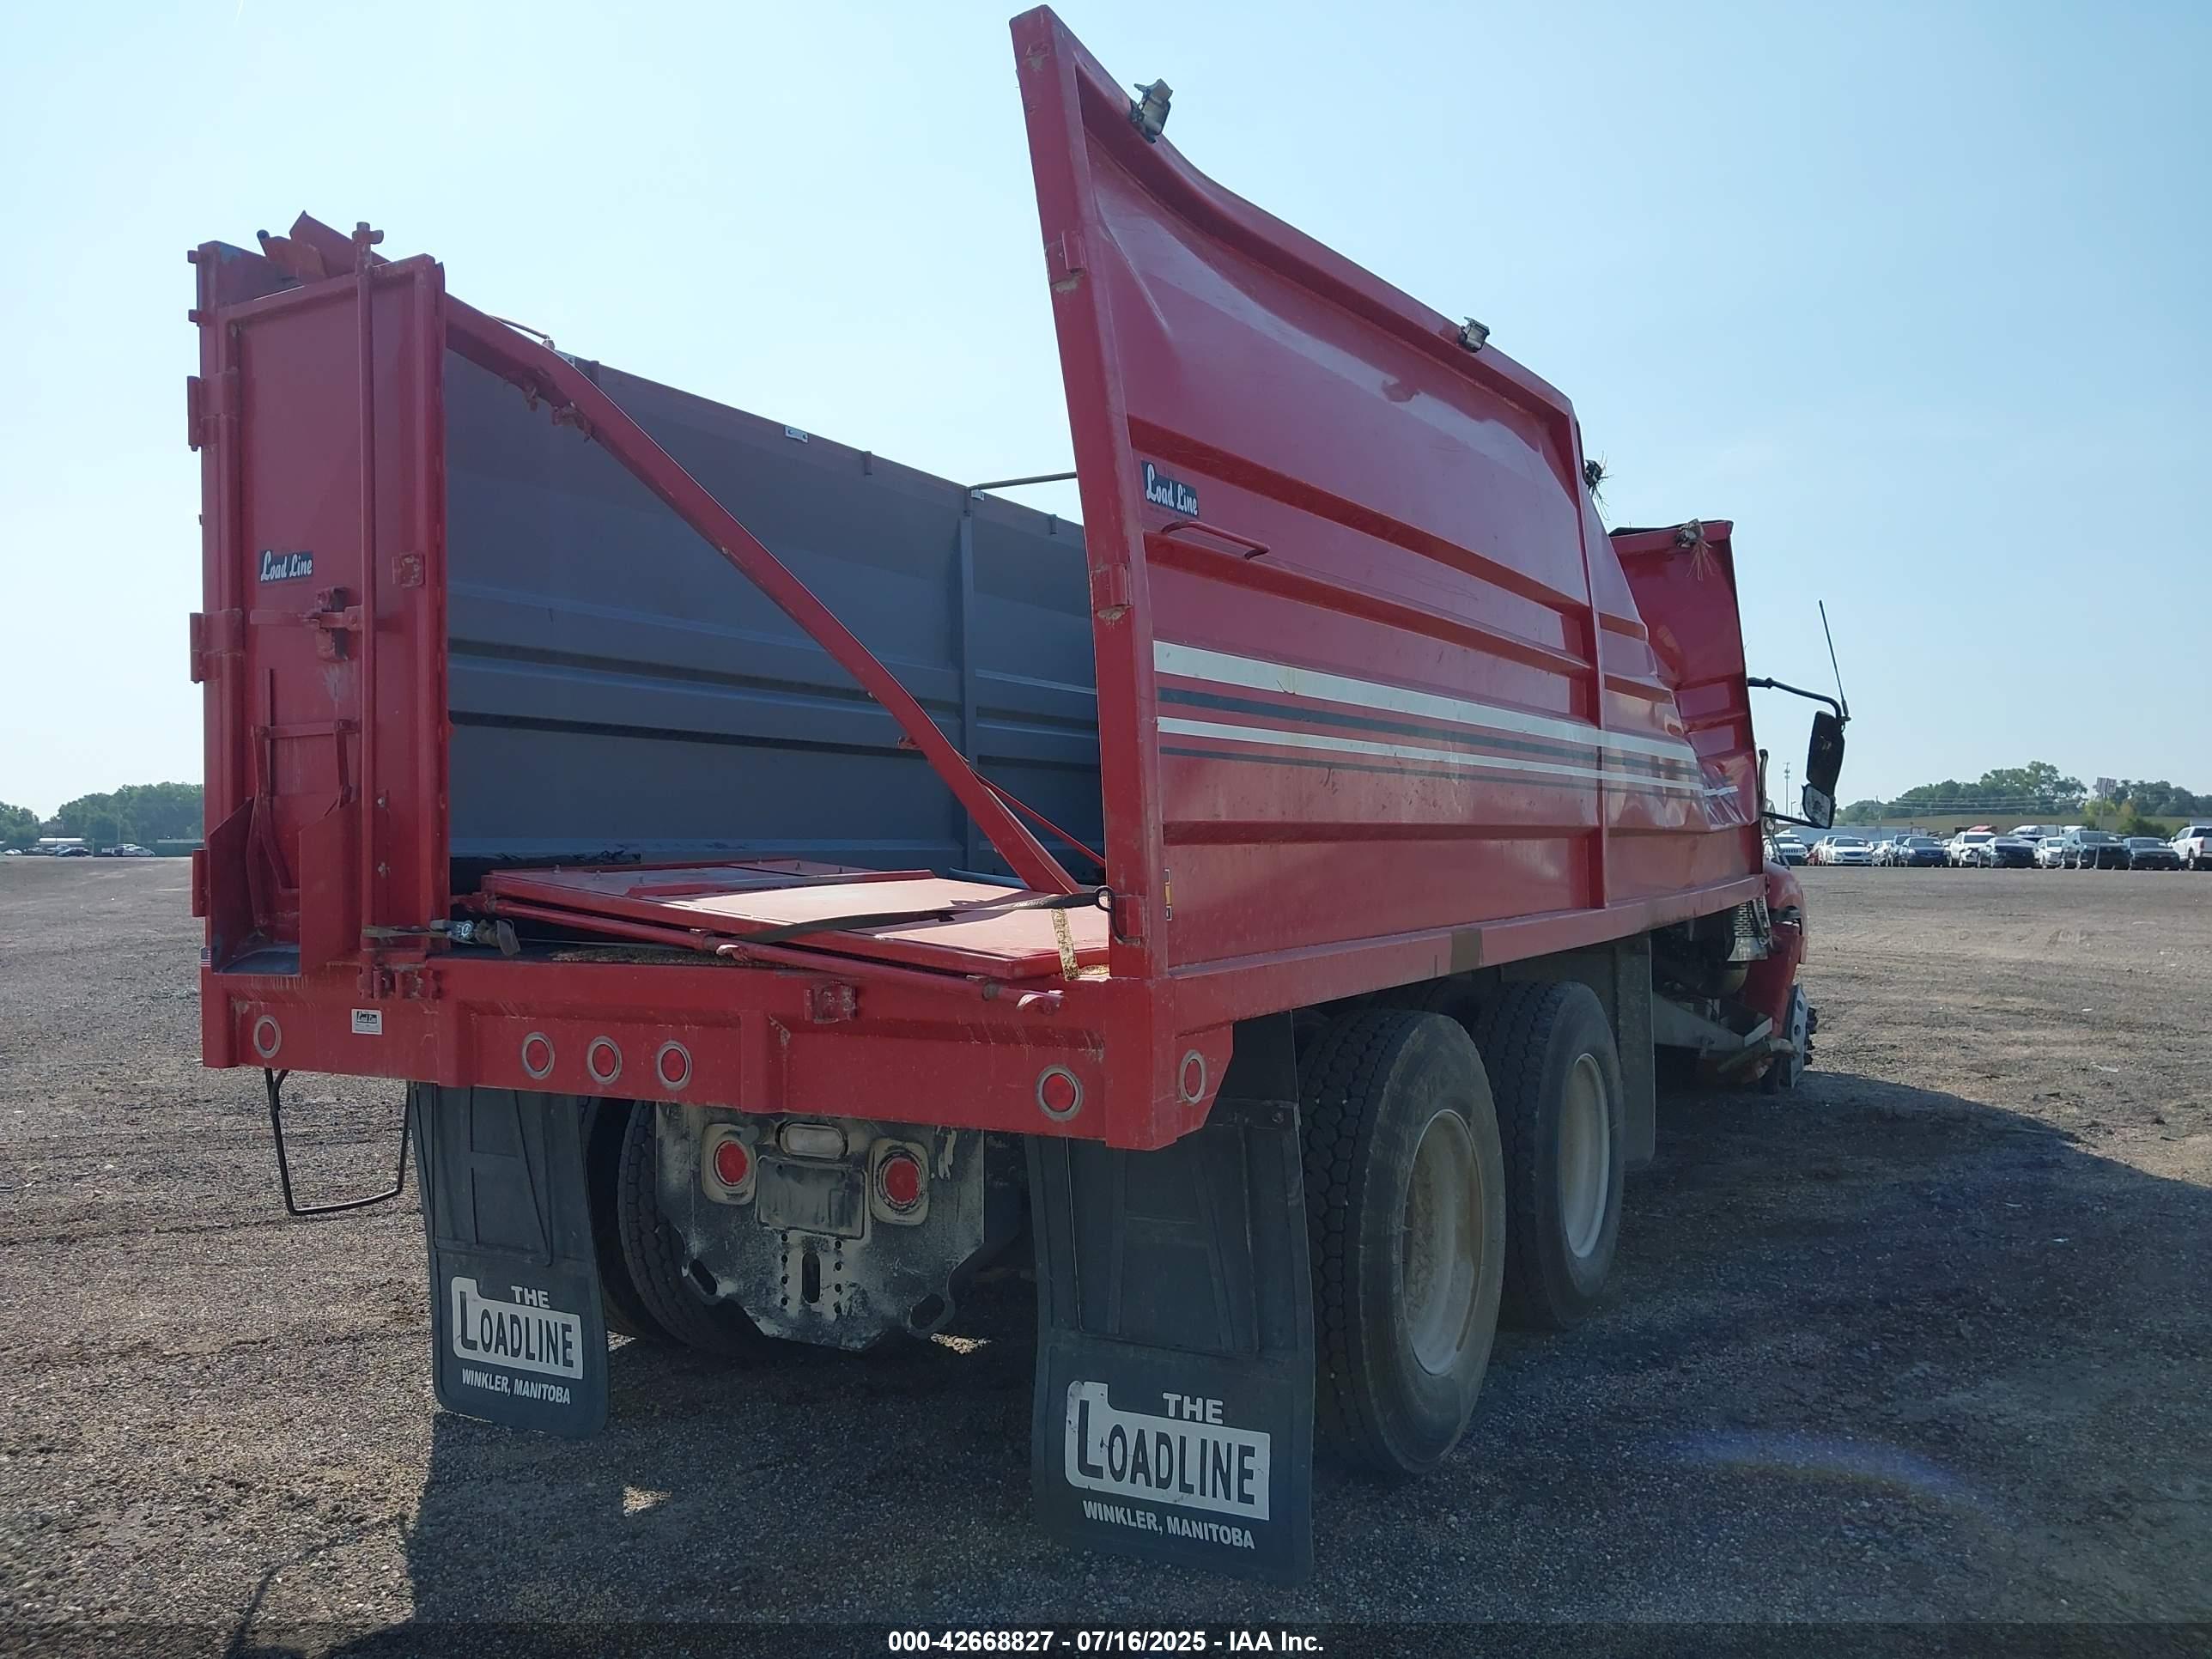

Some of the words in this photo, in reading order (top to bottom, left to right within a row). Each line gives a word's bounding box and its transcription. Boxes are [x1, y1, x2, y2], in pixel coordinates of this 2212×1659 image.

[1146, 464, 1175, 507] Load
[1176, 483, 1198, 516] Line
[260, 550, 288, 581] Load
[289, 554, 313, 578] Line
[511, 1285, 550, 1309] THE
[459, 1291, 574, 1368] LOADLINE
[462, 1368, 511, 1396] WINKLER,
[514, 1378, 571, 1405] MANITOBA
[1163, 1392, 1224, 1425] THE
[1077, 1399, 1256, 1505] LOADLINE
[1083, 1500, 1163, 1535] WINKLER,
[1167, 1516, 1255, 1550] MANITOBA
